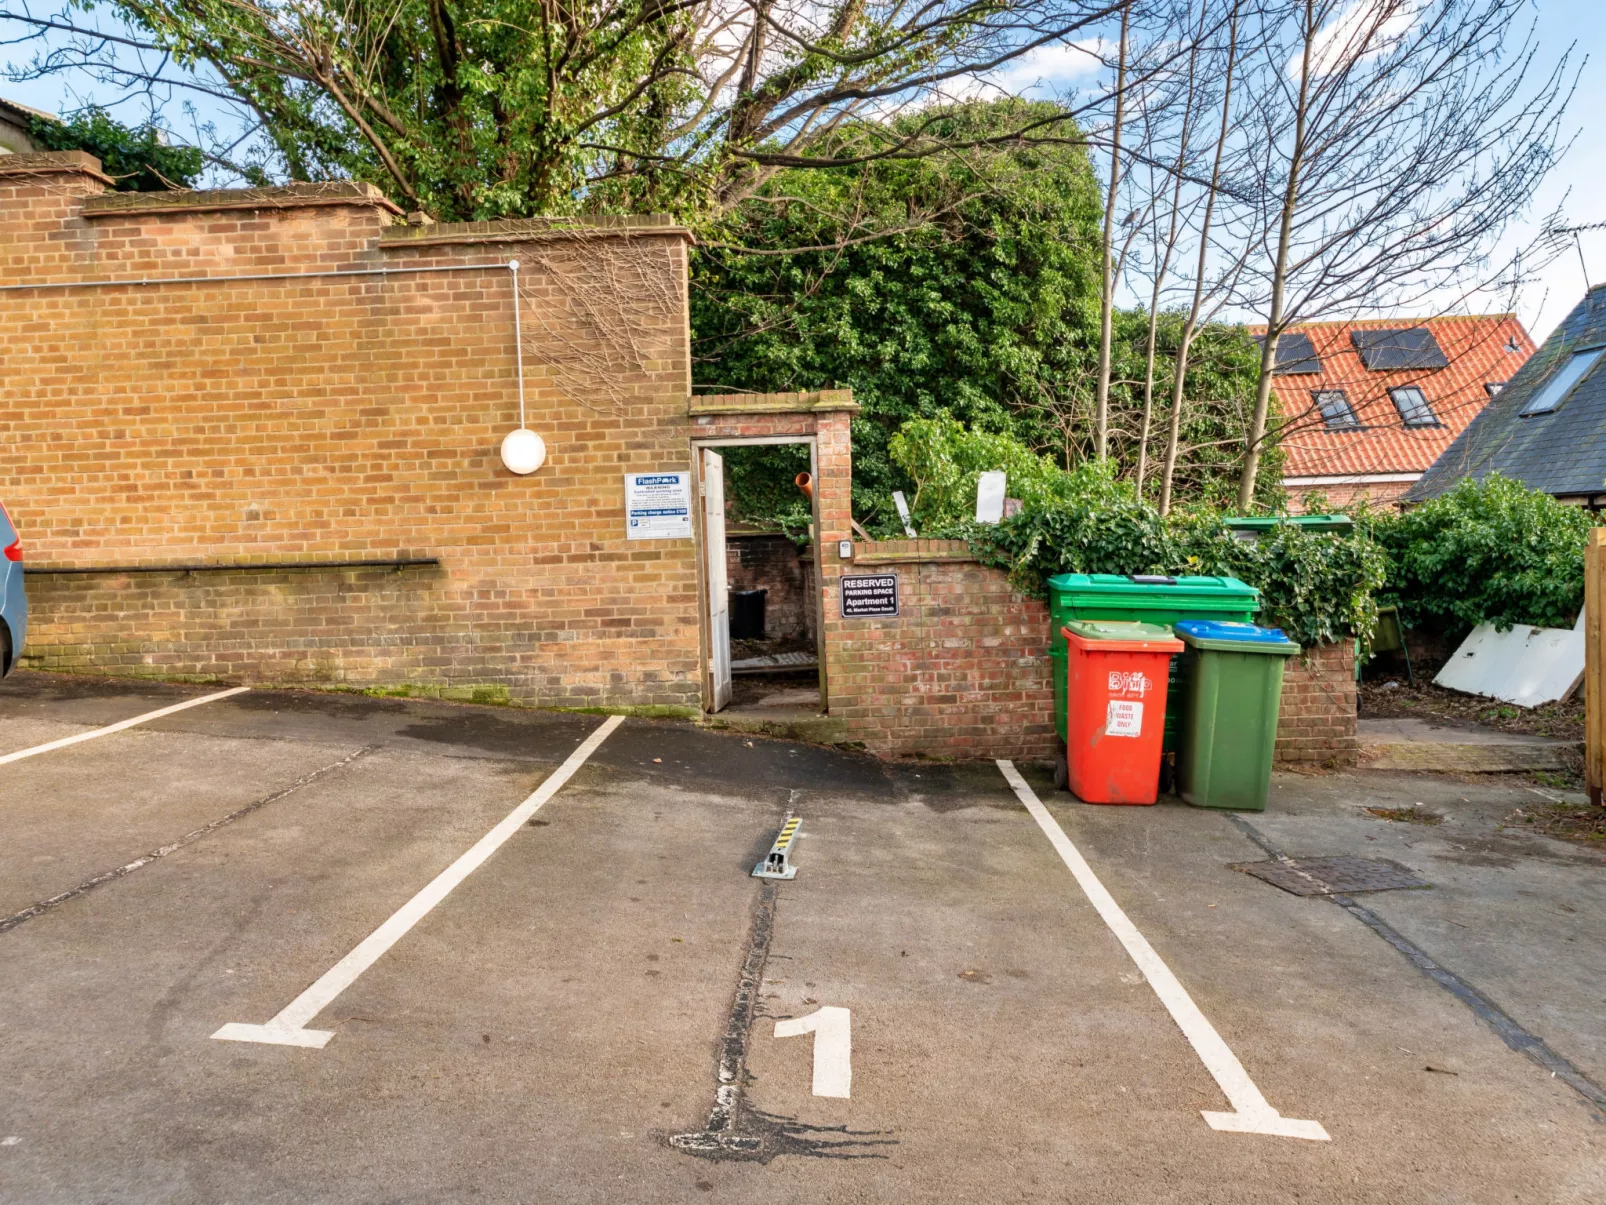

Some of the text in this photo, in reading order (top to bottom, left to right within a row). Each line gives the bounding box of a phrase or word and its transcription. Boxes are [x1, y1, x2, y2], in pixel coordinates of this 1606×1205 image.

[844, 579, 894, 588] RESERVED
[846, 598, 888, 607] Apartment
[773, 1005, 852, 1099] 1
